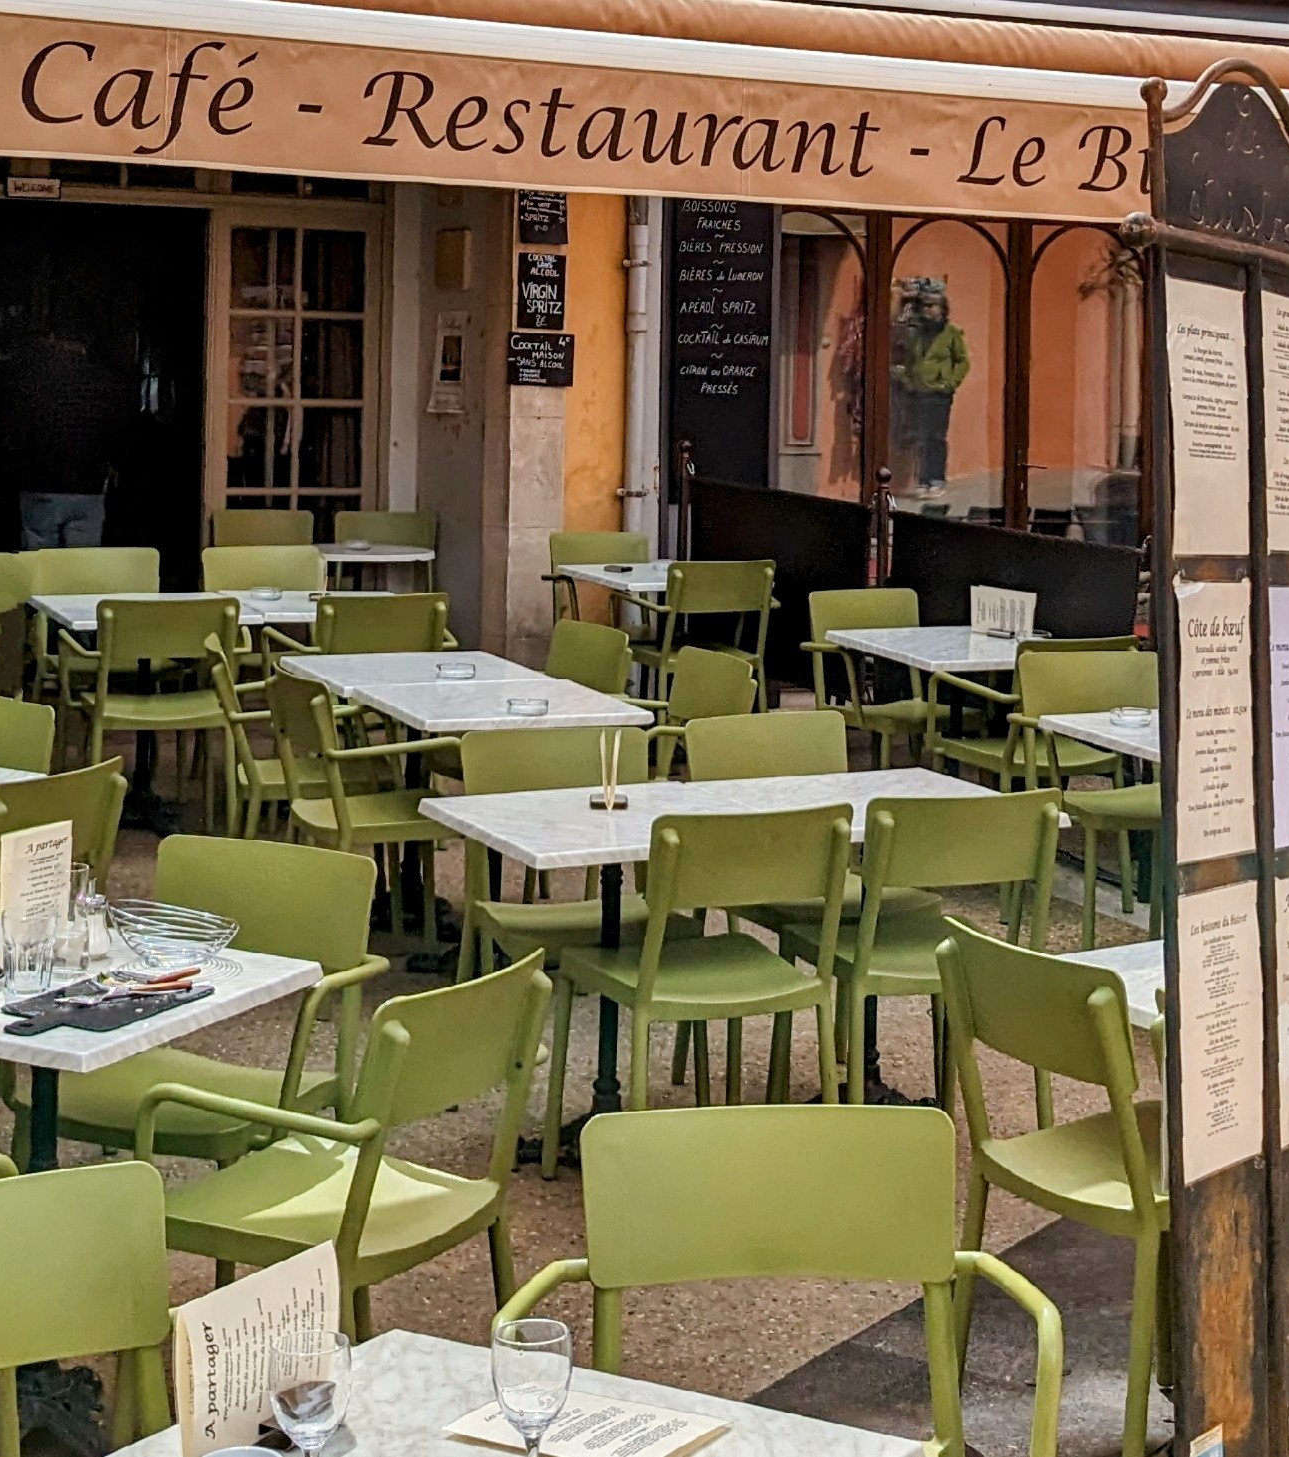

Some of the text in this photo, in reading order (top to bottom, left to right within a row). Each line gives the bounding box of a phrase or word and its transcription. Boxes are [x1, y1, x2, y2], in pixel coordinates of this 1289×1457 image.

[19, 41, 259, 162] Café
[363, 71, 880, 179] Restaurant
[956, 116, 1046, 187] Le
[682, 200, 737, 213] BOISSONS
[696, 216, 741, 231] FRAICHES
[679, 238, 764, 254] BIÈRES PRESSION
[530, 267, 560, 277] ALCOOL
[679, 267, 713, 282] BIÈRES
[522, 281, 557, 300] VIRGIN
[526, 299, 562, 314] SPRITZ
[722, 300, 757, 315] SPRITZ
[677, 331, 720, 344] COCKTAIL
[516, 355, 537, 368] SANS
[532, 351, 565, 360] MAISON
[722, 365, 757, 377] ORANGE
[1187, 618, 1208, 638] Côte
[1210, 615, 1220, 637] de
[201, 1321, 220, 1439] A partager
